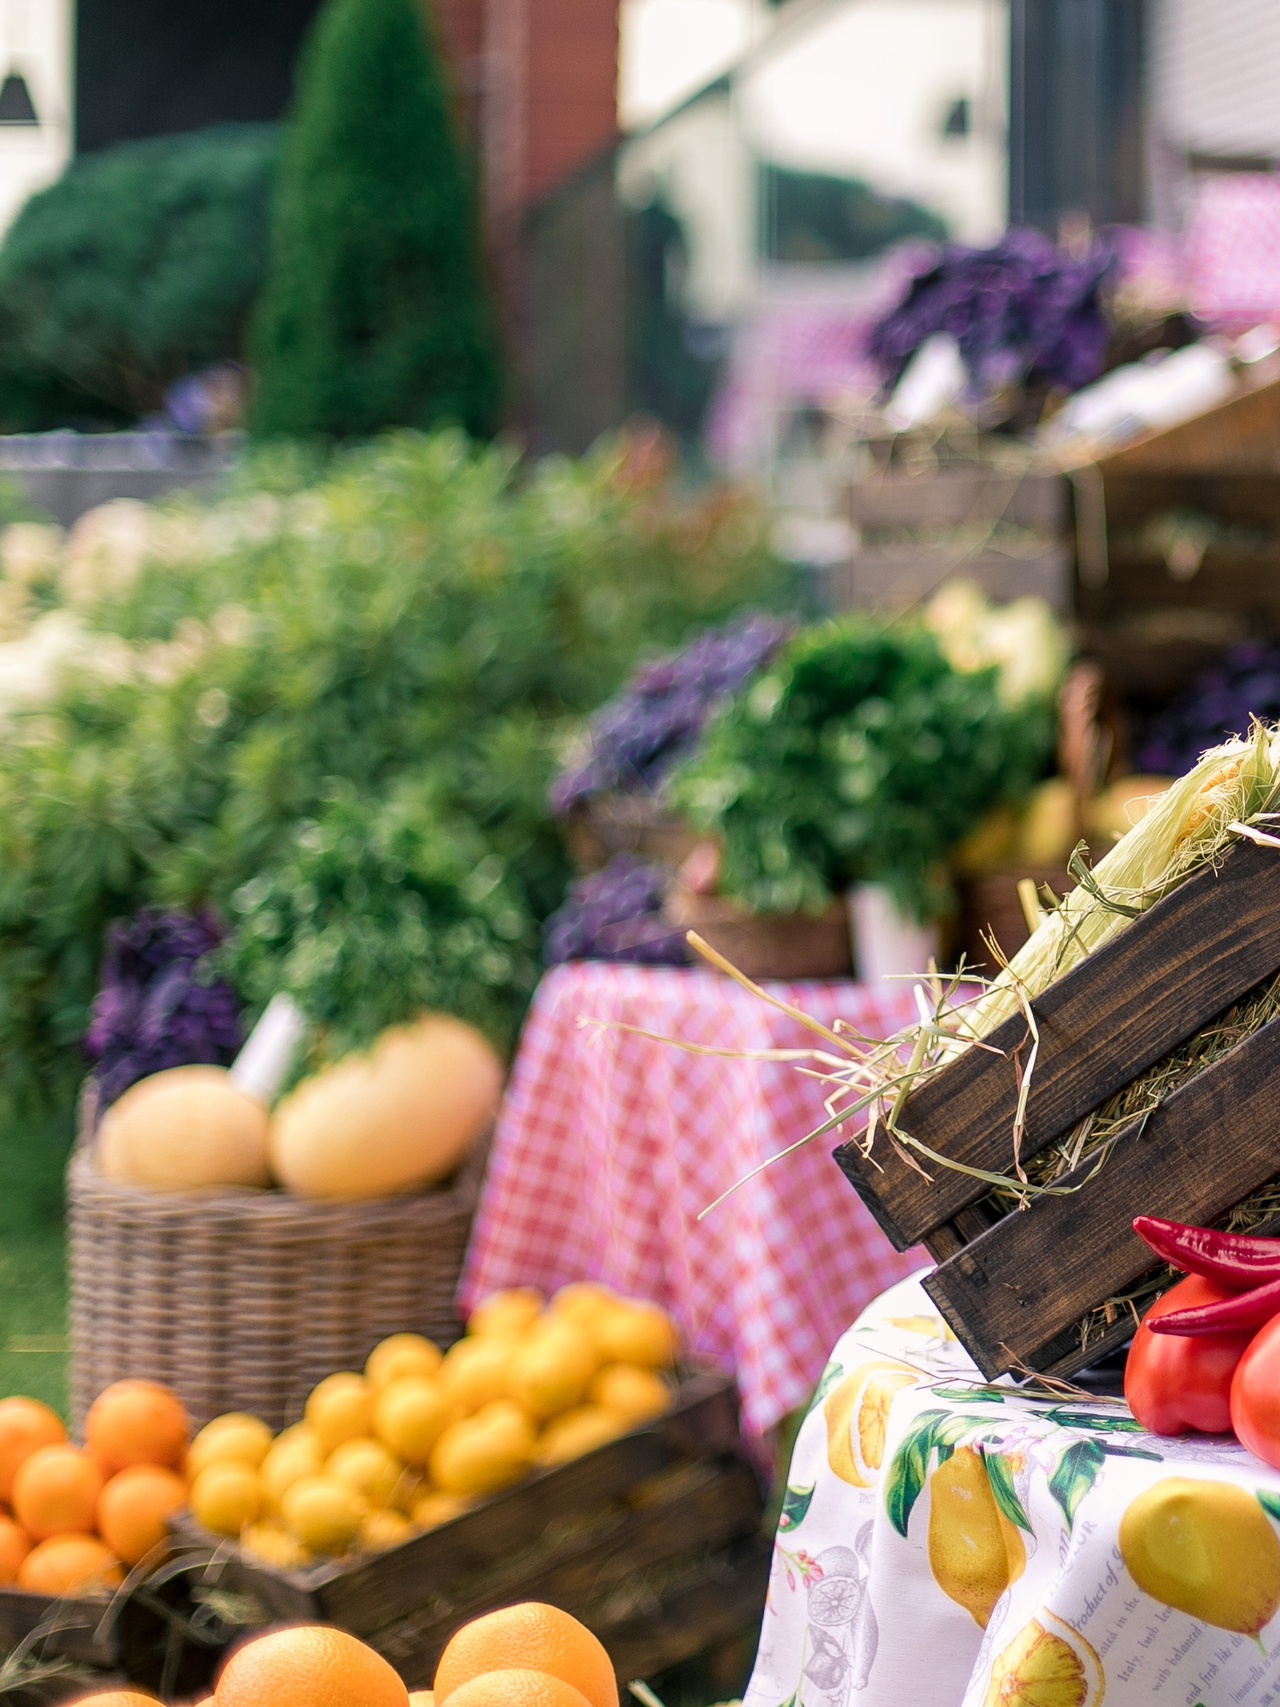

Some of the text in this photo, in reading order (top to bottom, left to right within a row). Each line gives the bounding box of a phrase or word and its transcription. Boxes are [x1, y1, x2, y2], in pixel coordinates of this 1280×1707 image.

[1104, 1562, 1121, 1589] of
[1116, 1652, 1145, 1683] Italy,
[1136, 1623, 1160, 1650] lush
[1150, 1623, 1204, 1693] with balanced
[1183, 1682, 1203, 1705] and
[1197, 1660, 1221, 1689] fresh
[1215, 1644, 1234, 1664] like
